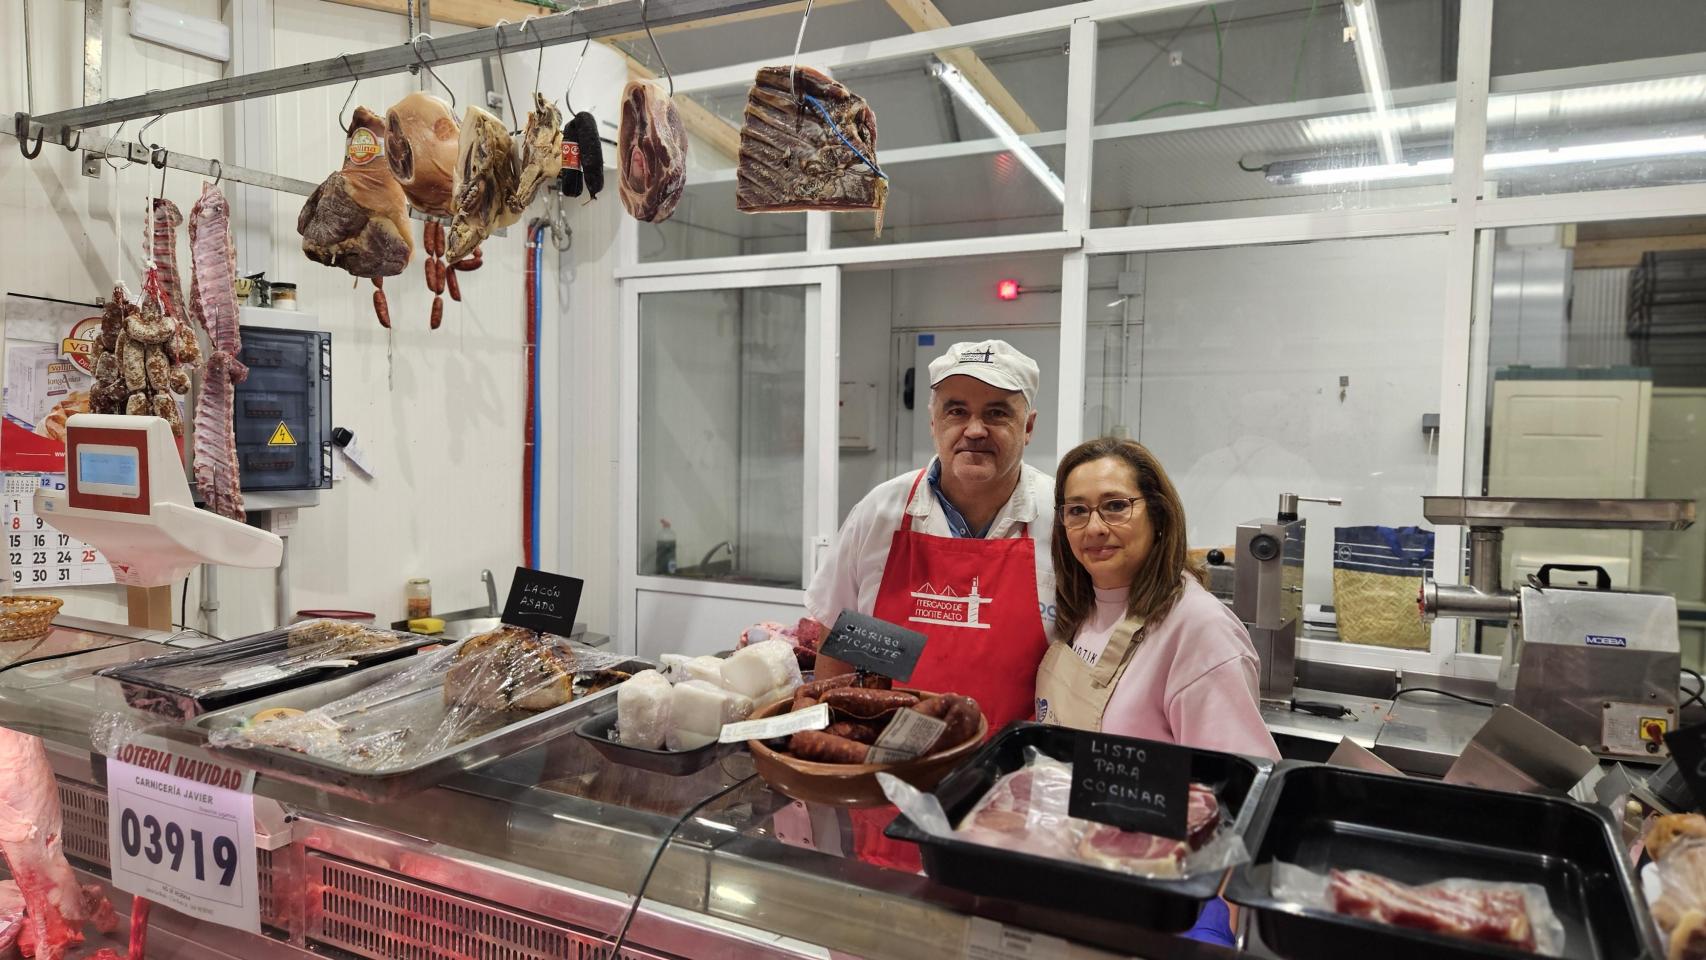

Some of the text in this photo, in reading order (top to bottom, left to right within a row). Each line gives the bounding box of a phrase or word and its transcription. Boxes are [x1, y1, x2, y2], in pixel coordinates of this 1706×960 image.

[13, 499, 18, 512] 1
[12, 517, 44, 529] 8 9
[9, 534, 70, 547] 15 16 17
[33, 552, 47, 564] 23
[57, 551, 72, 563] 24
[82, 550, 96, 562] 25
[33, 569, 47, 581] 30
[58, 568, 70, 580] 31
[523, 583, 561, 598] LACÓN
[519, 596, 556, 612] ASADO
[953, 603, 963, 612] DE
[915, 608, 963, 621] MONTE ALTO
[838, 634, 902, 660] PICANTE
[1091, 740, 1147, 763] LISTO
[174, 756, 242, 790] NAVIDAD
[1093, 758, 1141, 780] PARA
[135, 776, 214, 805] CARNICERÍA JAVIER
[1082, 778, 1167, 808] COCINAR
[121, 807, 238, 887] 03919
